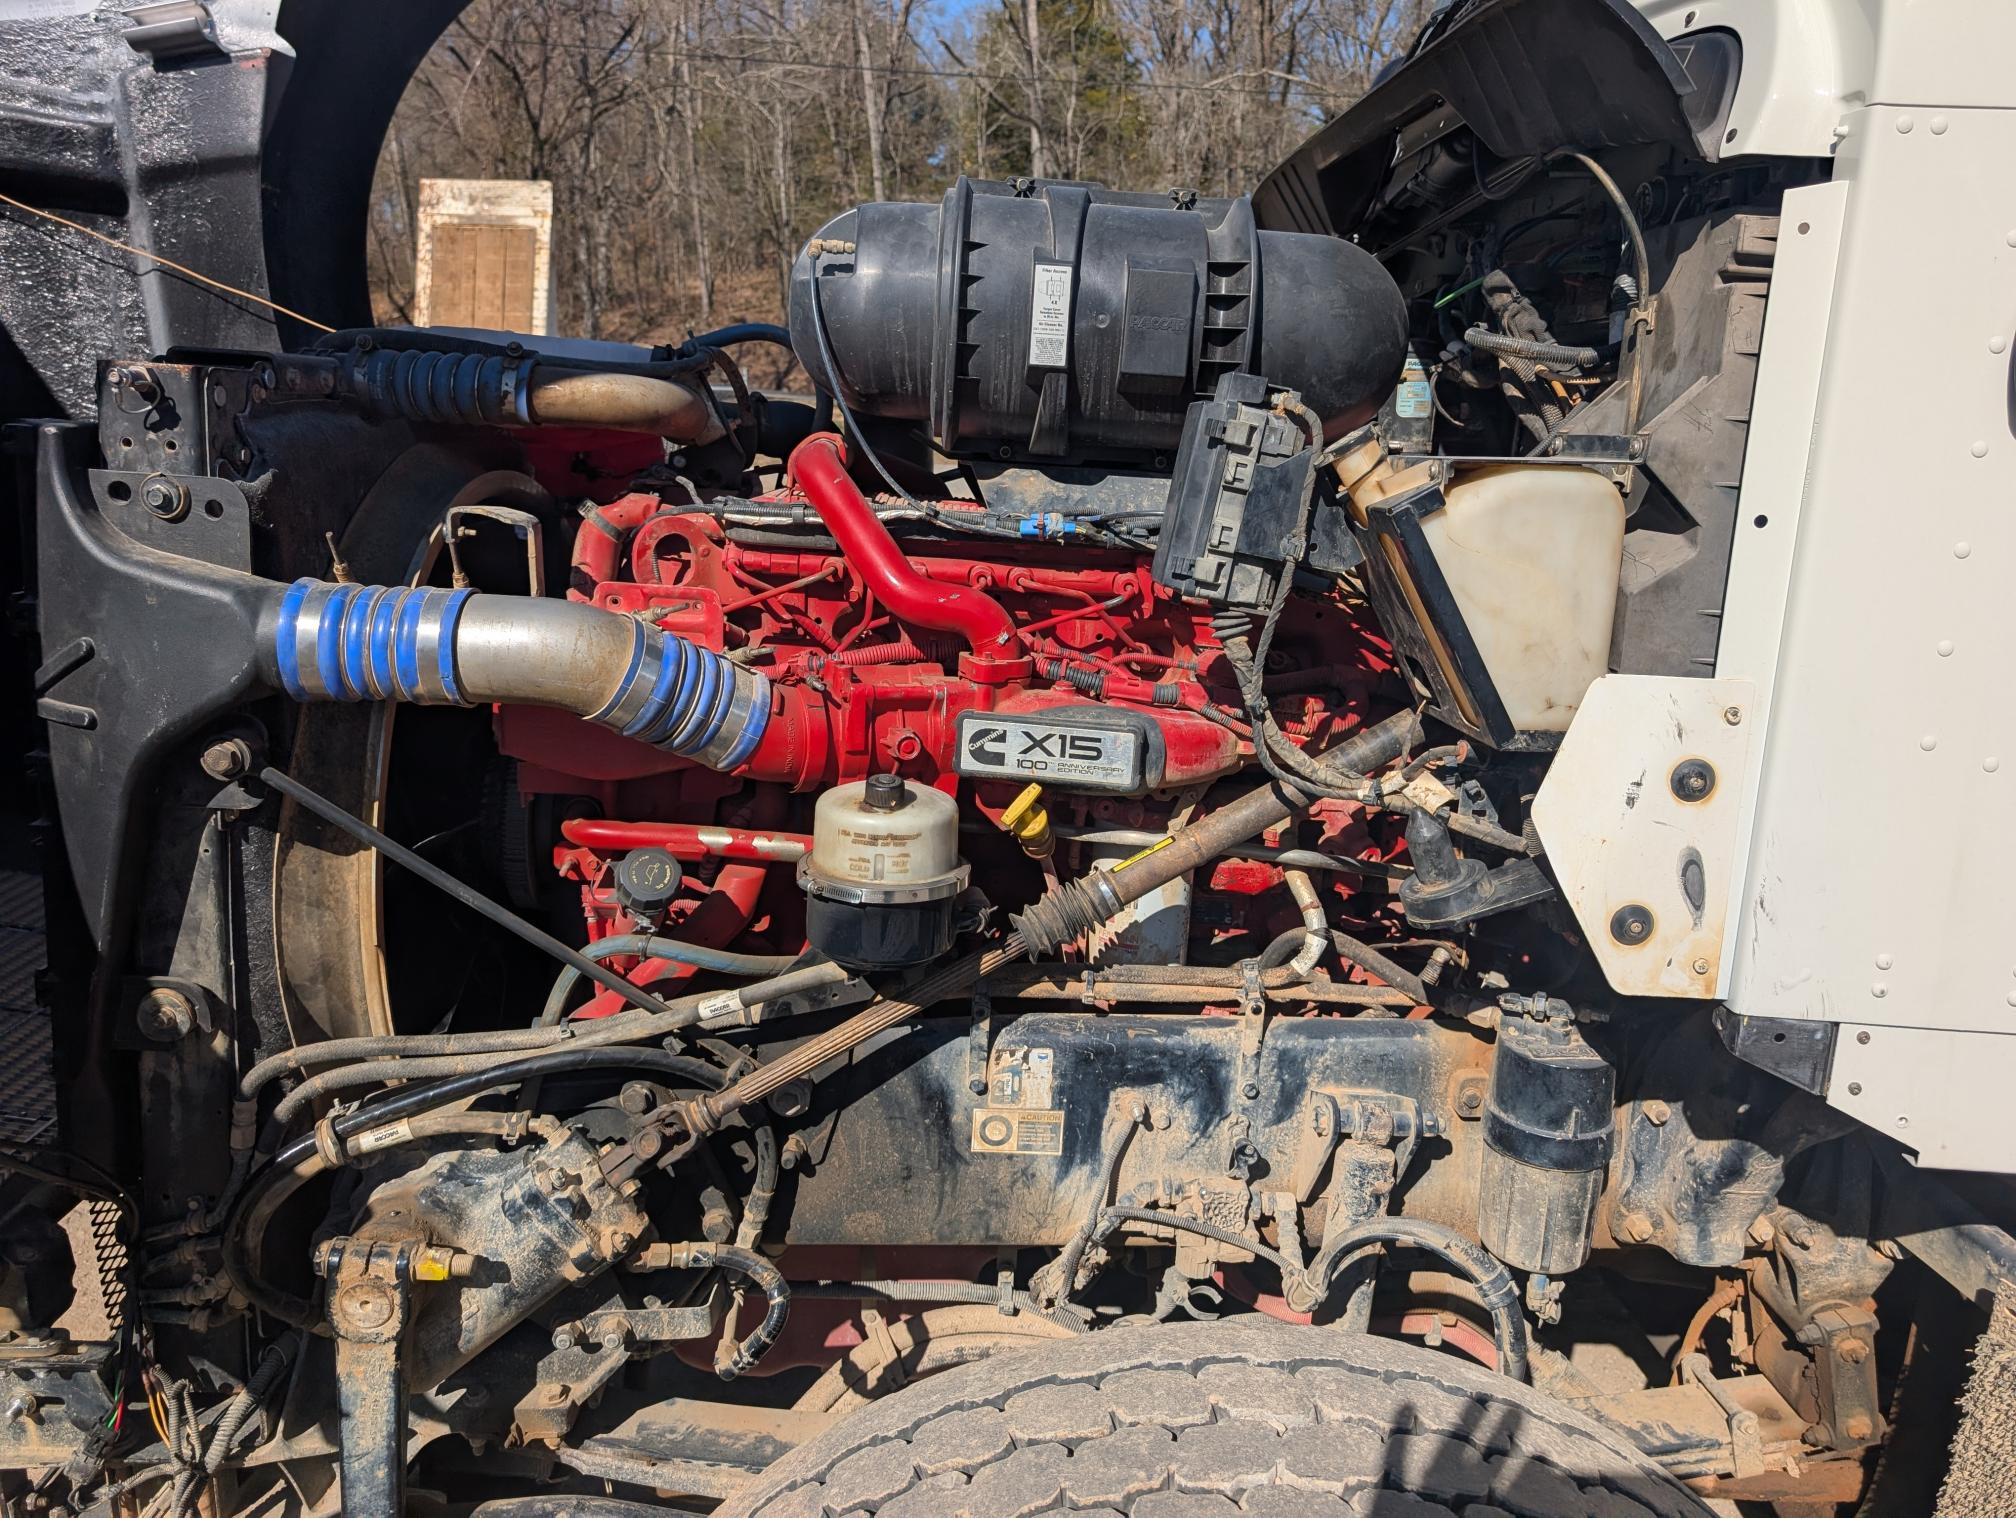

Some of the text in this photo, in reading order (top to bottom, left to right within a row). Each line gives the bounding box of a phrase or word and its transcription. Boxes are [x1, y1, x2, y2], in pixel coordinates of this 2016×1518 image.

[968, 729, 1004, 751] Cummins
[1017, 730, 1103, 761] X15
[1057, 762, 1125, 773] ANNIVERSARY
[1057, 767, 1094, 775] EDITION
[1026, 1113, 1063, 1121] CAUTION
